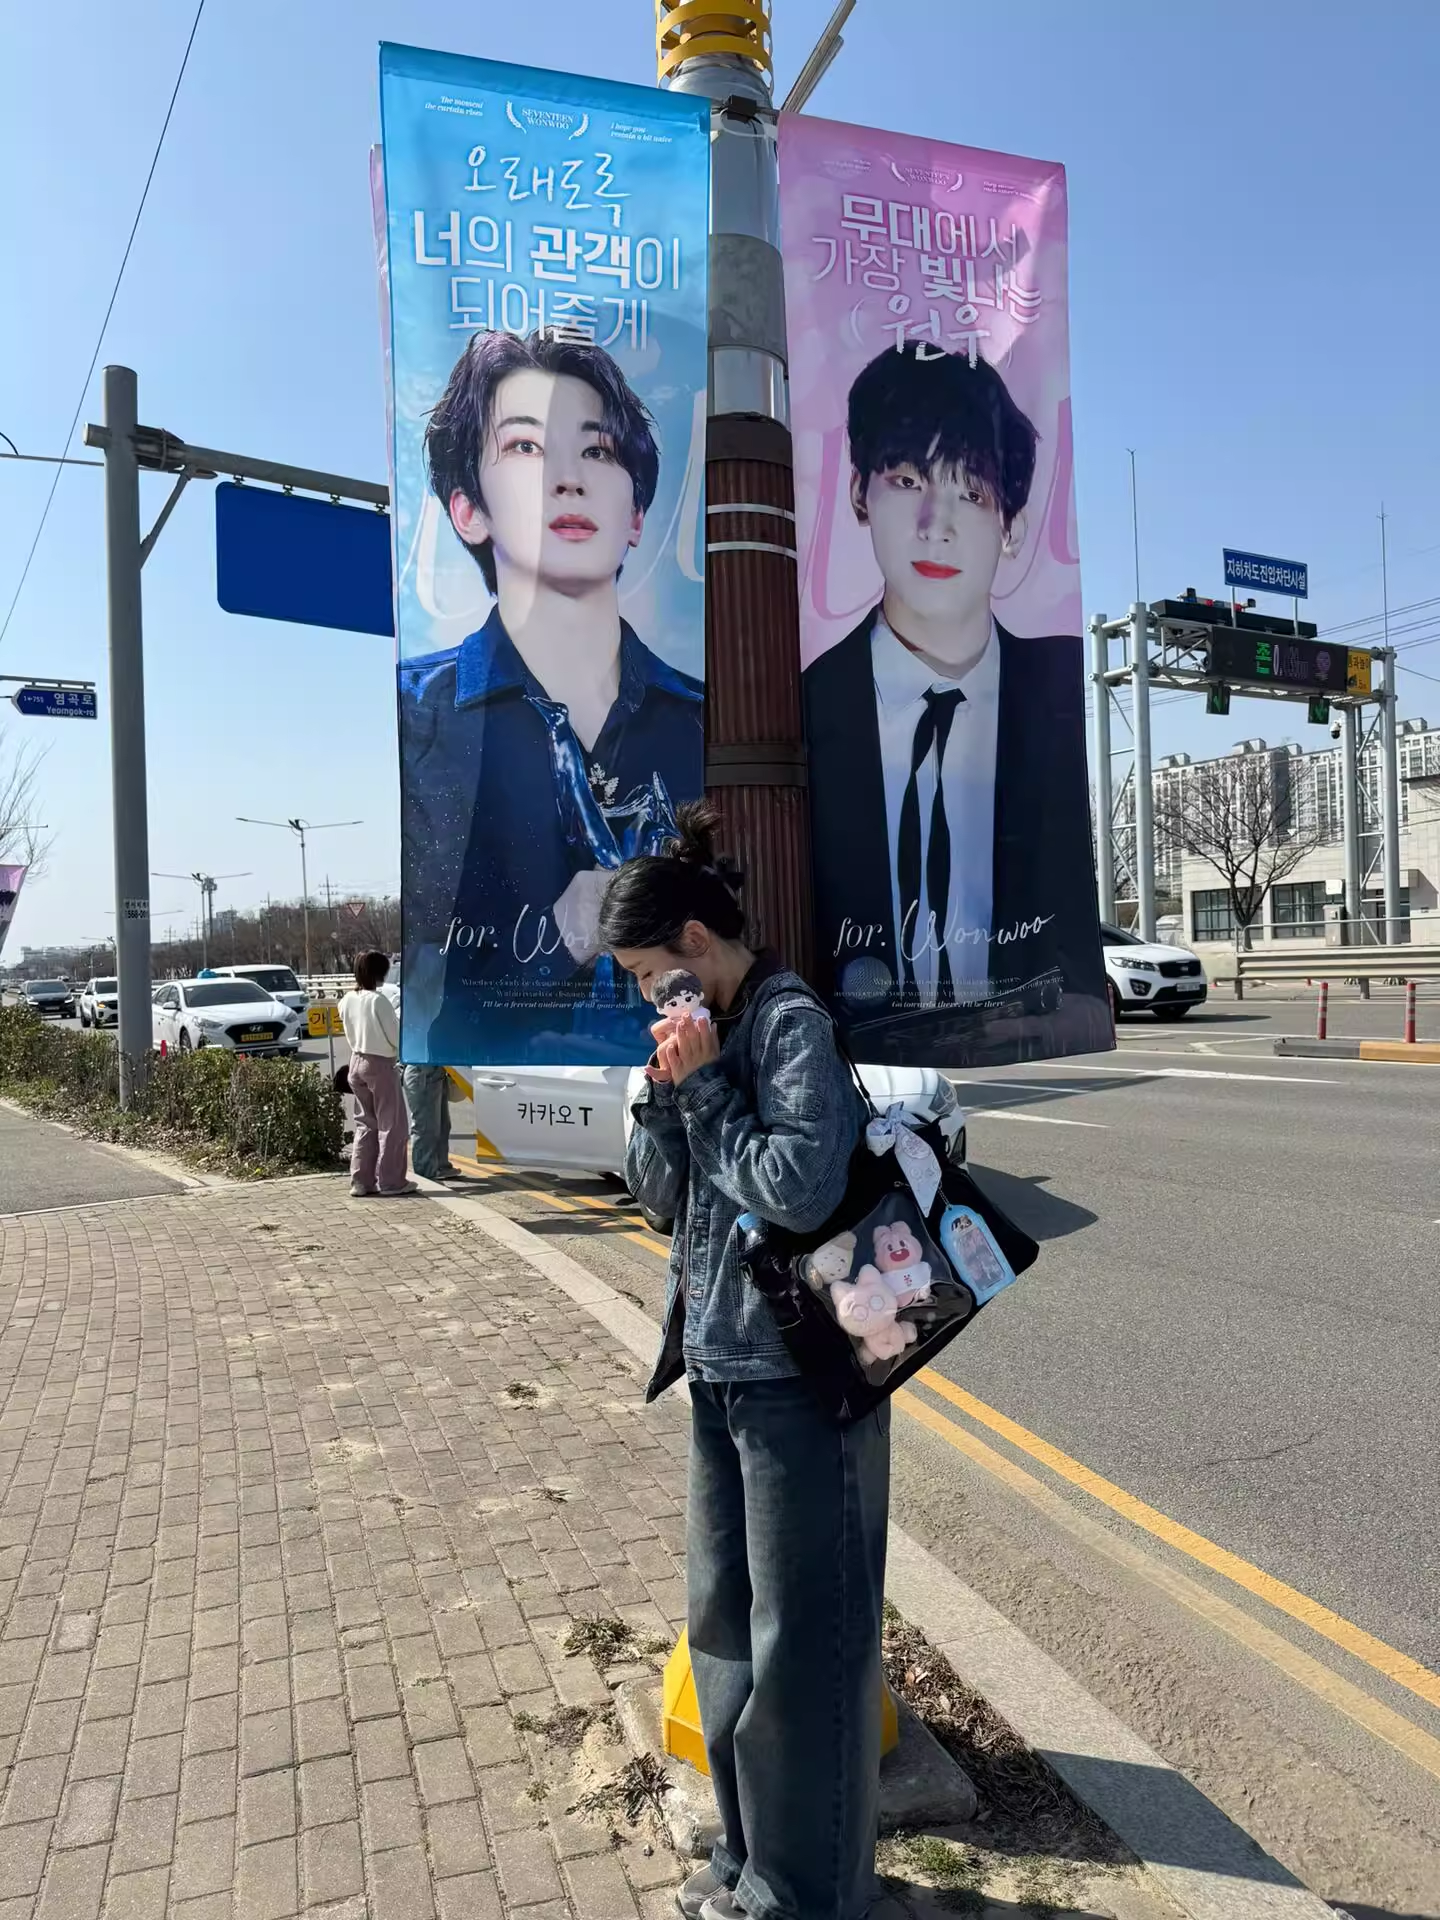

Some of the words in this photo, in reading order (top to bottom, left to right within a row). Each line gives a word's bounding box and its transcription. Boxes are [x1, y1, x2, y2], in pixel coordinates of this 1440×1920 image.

[522, 108, 574, 124] SEVENTEEN
[527, 116, 571, 130] WONWOO
[464, 144, 632, 229] 오래도록
[413, 209, 513, 274] 너의
[529, 223, 680, 290] 관객이
[840, 193, 1017, 268] 무대에서
[811, 236, 905, 293] 가장
[919, 254, 1042, 324] 빛나는
[449, 275, 649, 352] 되어줄게
[881, 294, 991, 370] 원우
[1227, 558, 1306, 590] 지하차도진입차단시설
[46, 705, 95, 717] Yeomgok-ro
[53, 692, 94, 706] 염곡로
[439, 916, 498, 955] for.
[833, 916, 886, 958] for.
[901, 896, 1055, 961] Wonwoo
[517, 1102, 576, 1126] 카카오
[578, 1106, 593, 1127] T
